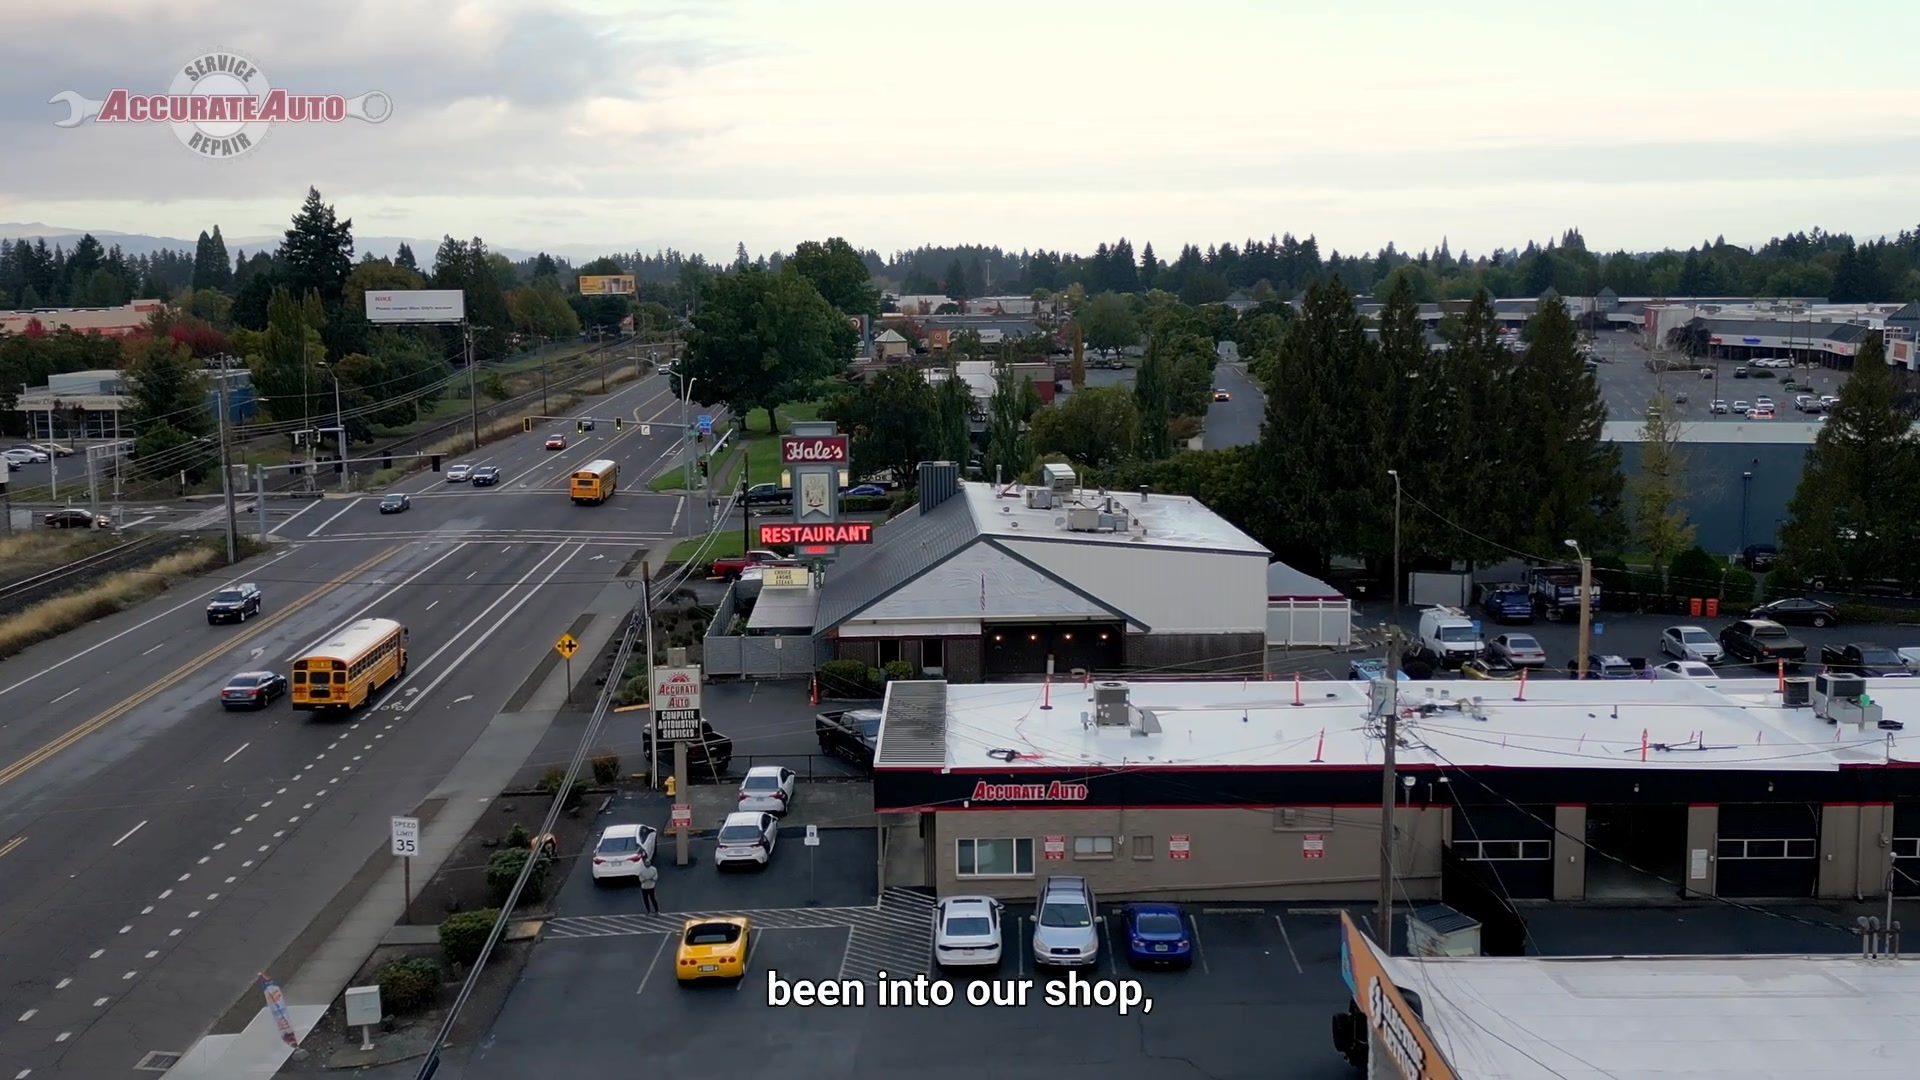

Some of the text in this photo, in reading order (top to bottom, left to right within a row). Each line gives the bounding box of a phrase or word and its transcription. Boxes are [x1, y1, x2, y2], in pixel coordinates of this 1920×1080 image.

[786, 440, 843, 460] Hale's
[761, 526, 870, 543] RESTAURANT
[657, 682, 698, 695] ACCURATE
[668, 695, 690, 708] AUTO
[661, 711, 695, 720] COMPLETE
[658, 720, 698, 730] AUTOMOTIVE
[662, 729, 695, 738] SERVICES
[971, 780, 1088, 801] ACCURATE AUTO
[394, 821, 417, 829] SPEED
[396, 839, 415, 852] 35
